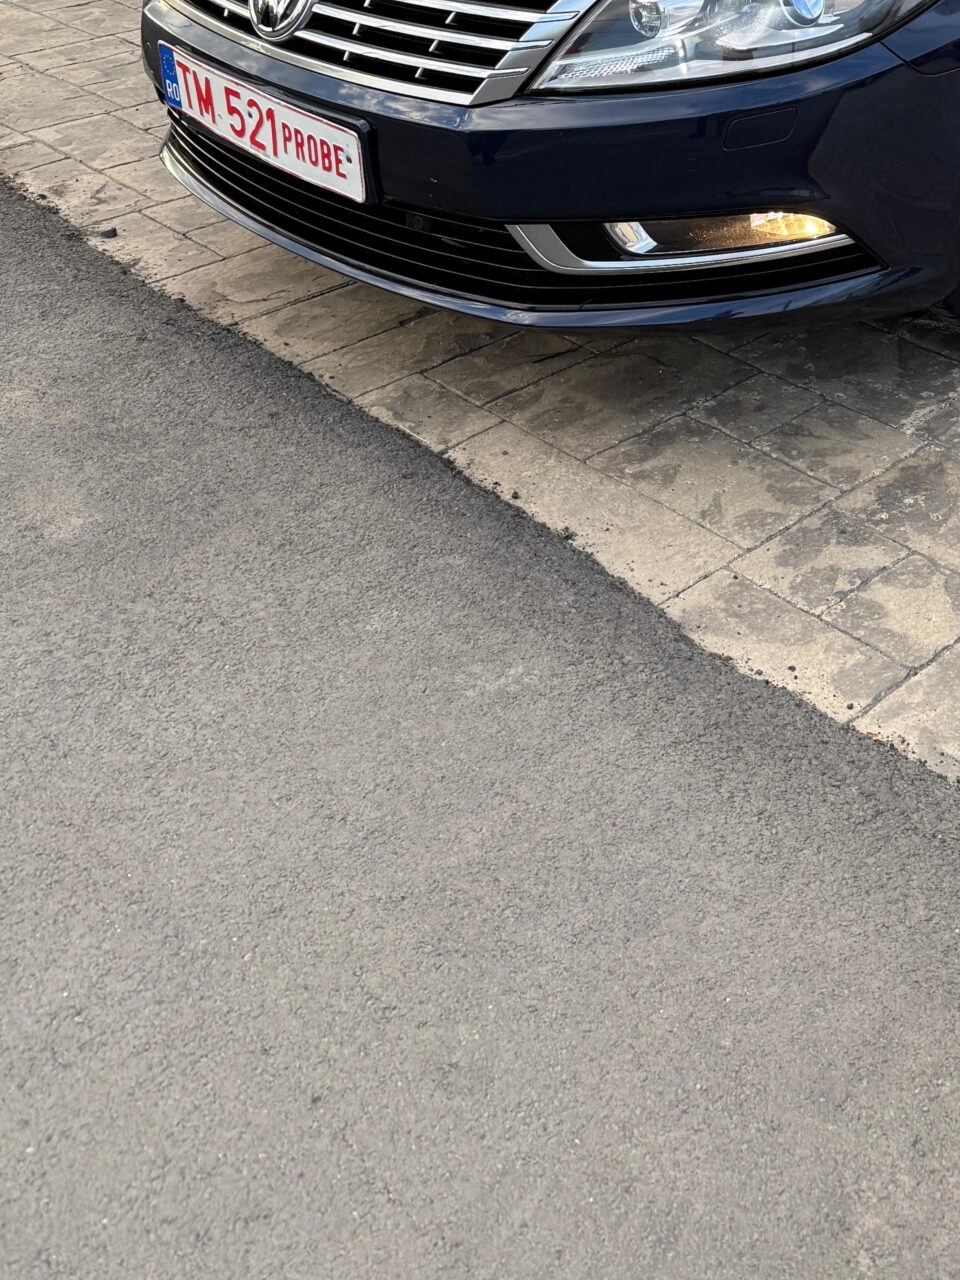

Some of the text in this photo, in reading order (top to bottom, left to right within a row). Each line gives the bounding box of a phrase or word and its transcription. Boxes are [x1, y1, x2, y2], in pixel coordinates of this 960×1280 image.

[165, 79, 181, 102] RO
[175, 59, 348, 180] TM 521 PROBE
